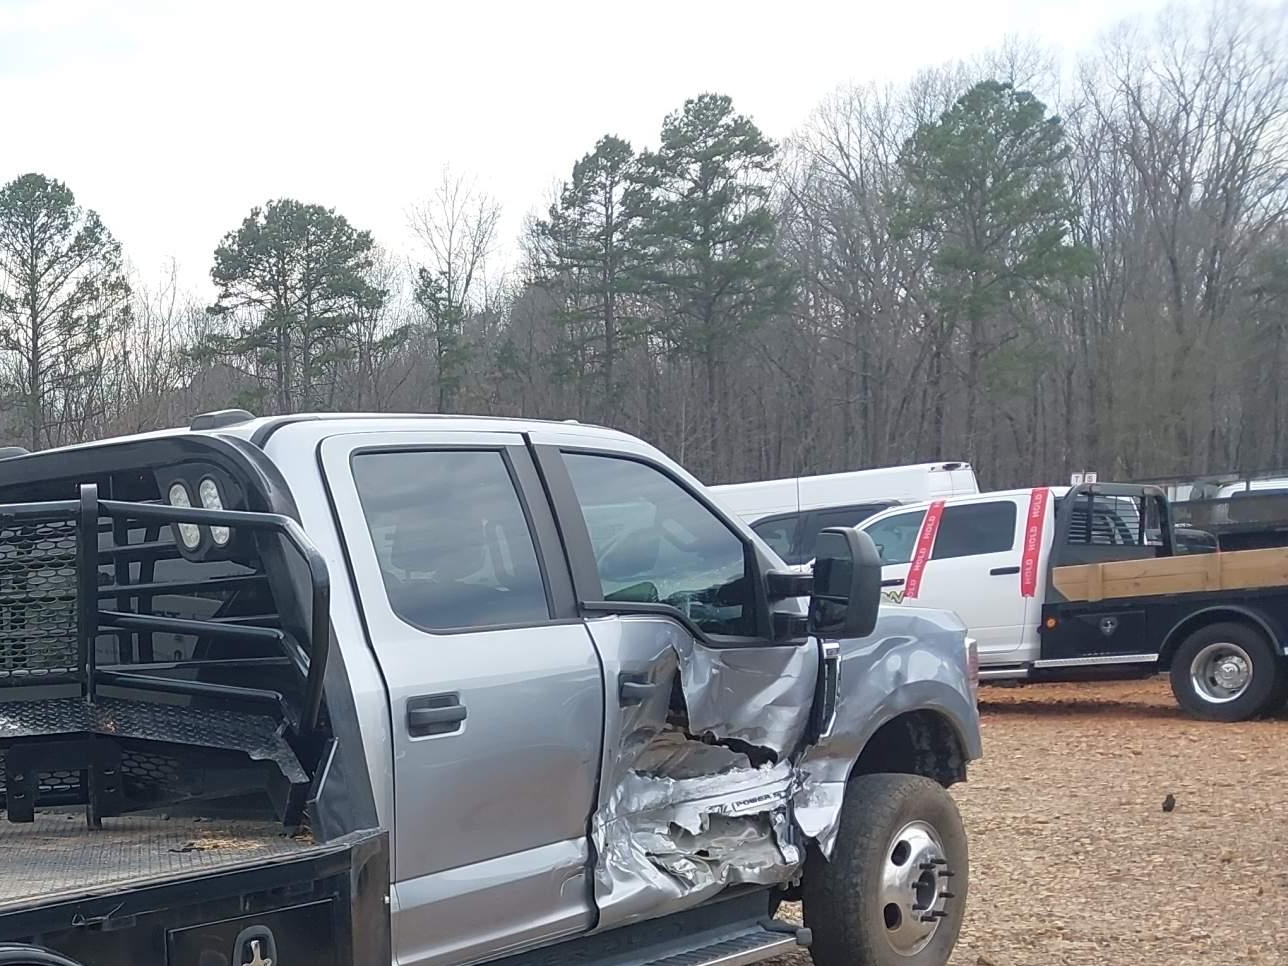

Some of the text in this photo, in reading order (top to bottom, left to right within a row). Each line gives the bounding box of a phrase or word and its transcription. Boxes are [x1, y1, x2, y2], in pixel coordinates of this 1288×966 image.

[913, 547, 927, 571] HOLD
[923, 515, 936, 540] HOLD
[1024, 493, 1043, 585] HOLD HOLD HOLD
